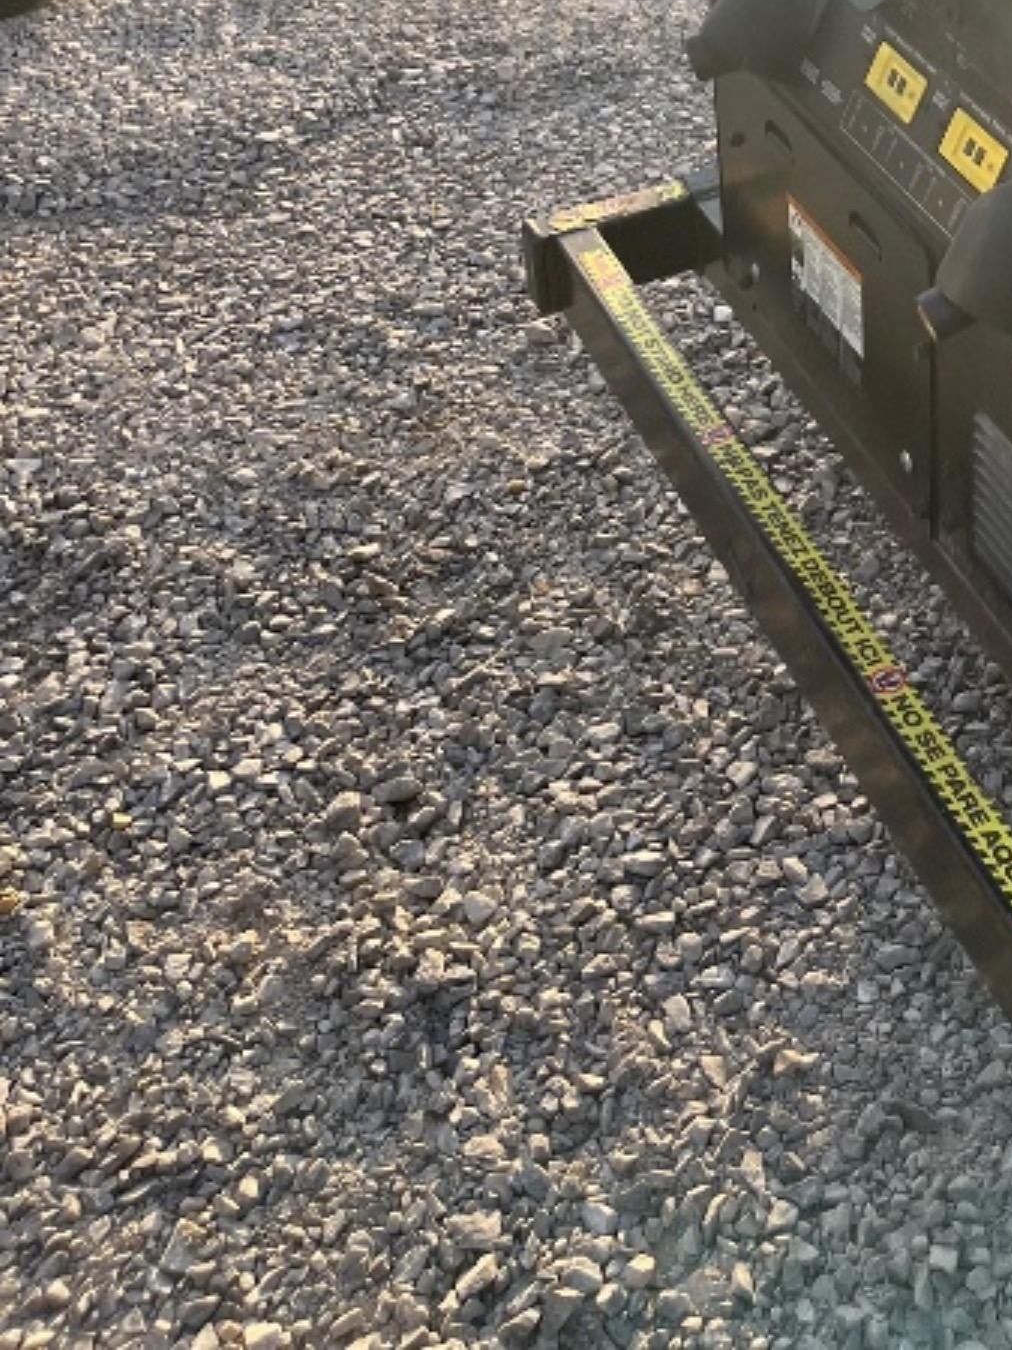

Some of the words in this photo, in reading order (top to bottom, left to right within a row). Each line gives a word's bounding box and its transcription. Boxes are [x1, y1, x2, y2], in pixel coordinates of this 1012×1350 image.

[803, 558, 864, 636] DEBOUT
[857, 638, 883, 666] ICI
[892, 693, 922, 727] NO
[916, 730, 945, 763] SE
[940, 763, 990, 828] PARE
